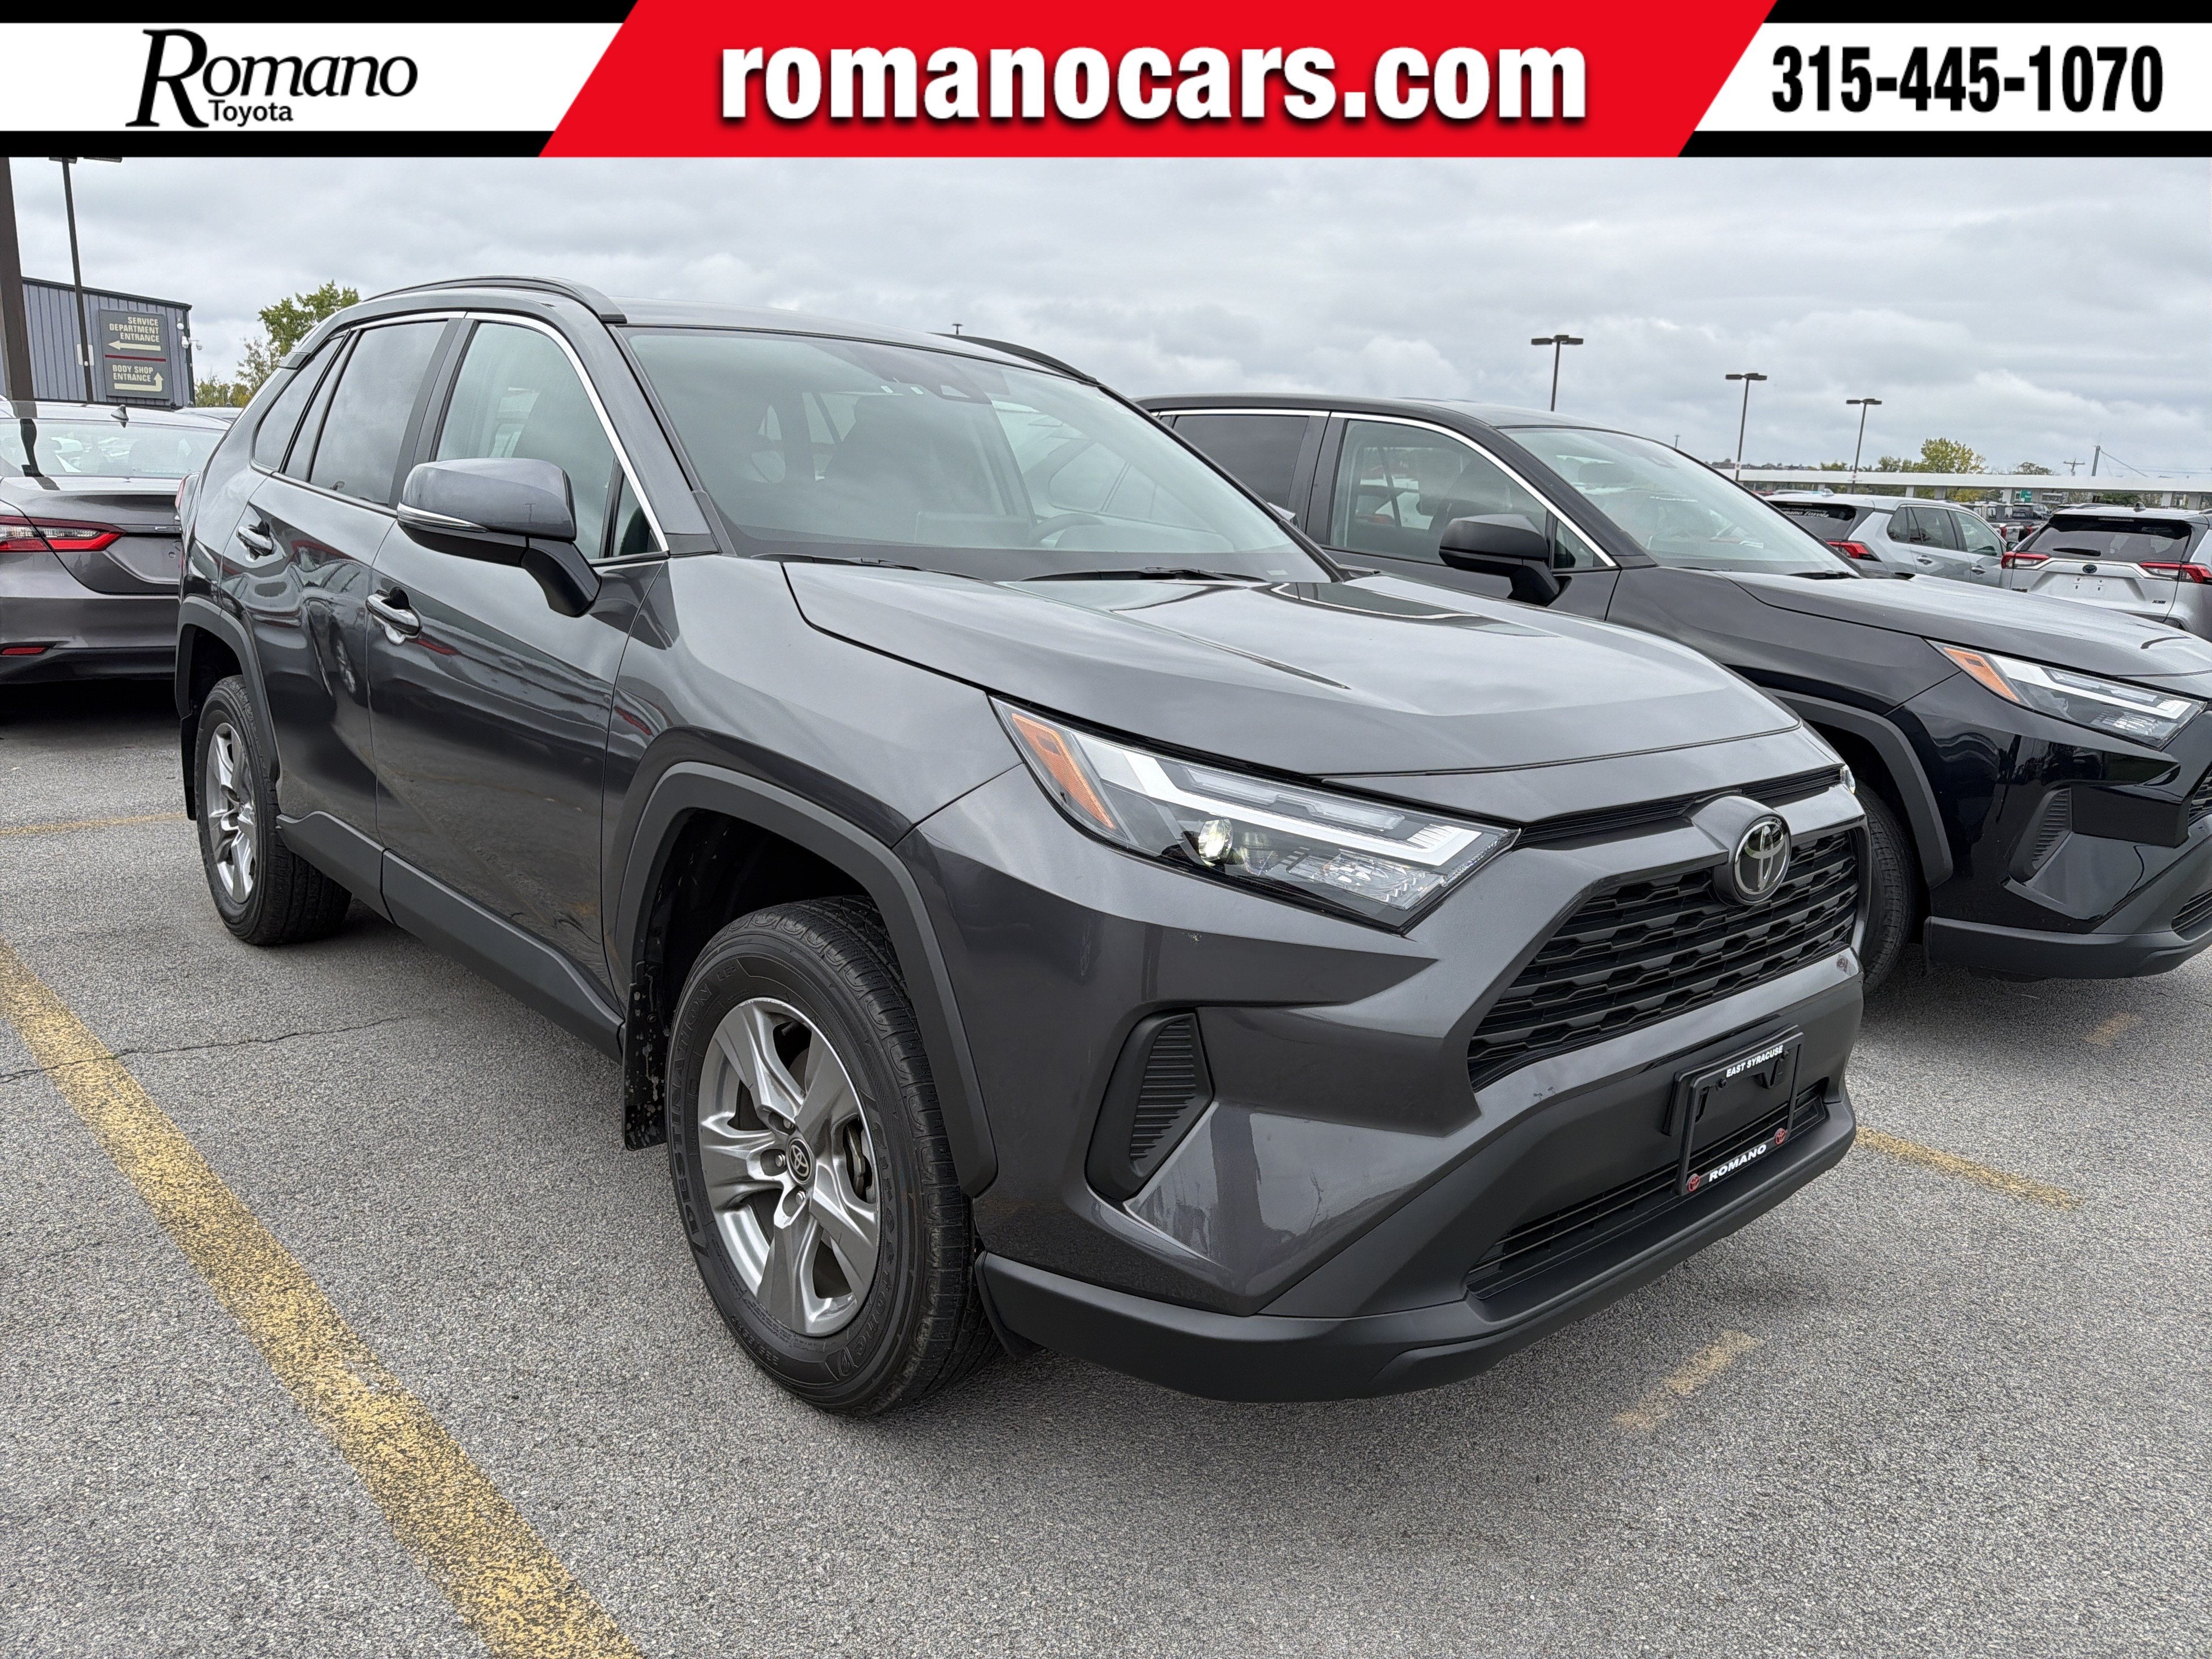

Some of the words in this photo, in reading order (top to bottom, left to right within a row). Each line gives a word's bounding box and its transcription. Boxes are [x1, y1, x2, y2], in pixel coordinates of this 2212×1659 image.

[127, 317, 158, 326] SERVICE
[109, 323, 159, 334] DEPARTMENT
[120, 332, 160, 342] ENTRANCE
[112, 364, 132, 373] BODY
[134, 365, 154, 374] SHOP
[113, 373, 151, 382] ENTRANCE
[1726, 1062, 1746, 1078] EAST
[1747, 1045, 1783, 1069] SYRACUSE
[1708, 1144, 1767, 1182] ROMANO
